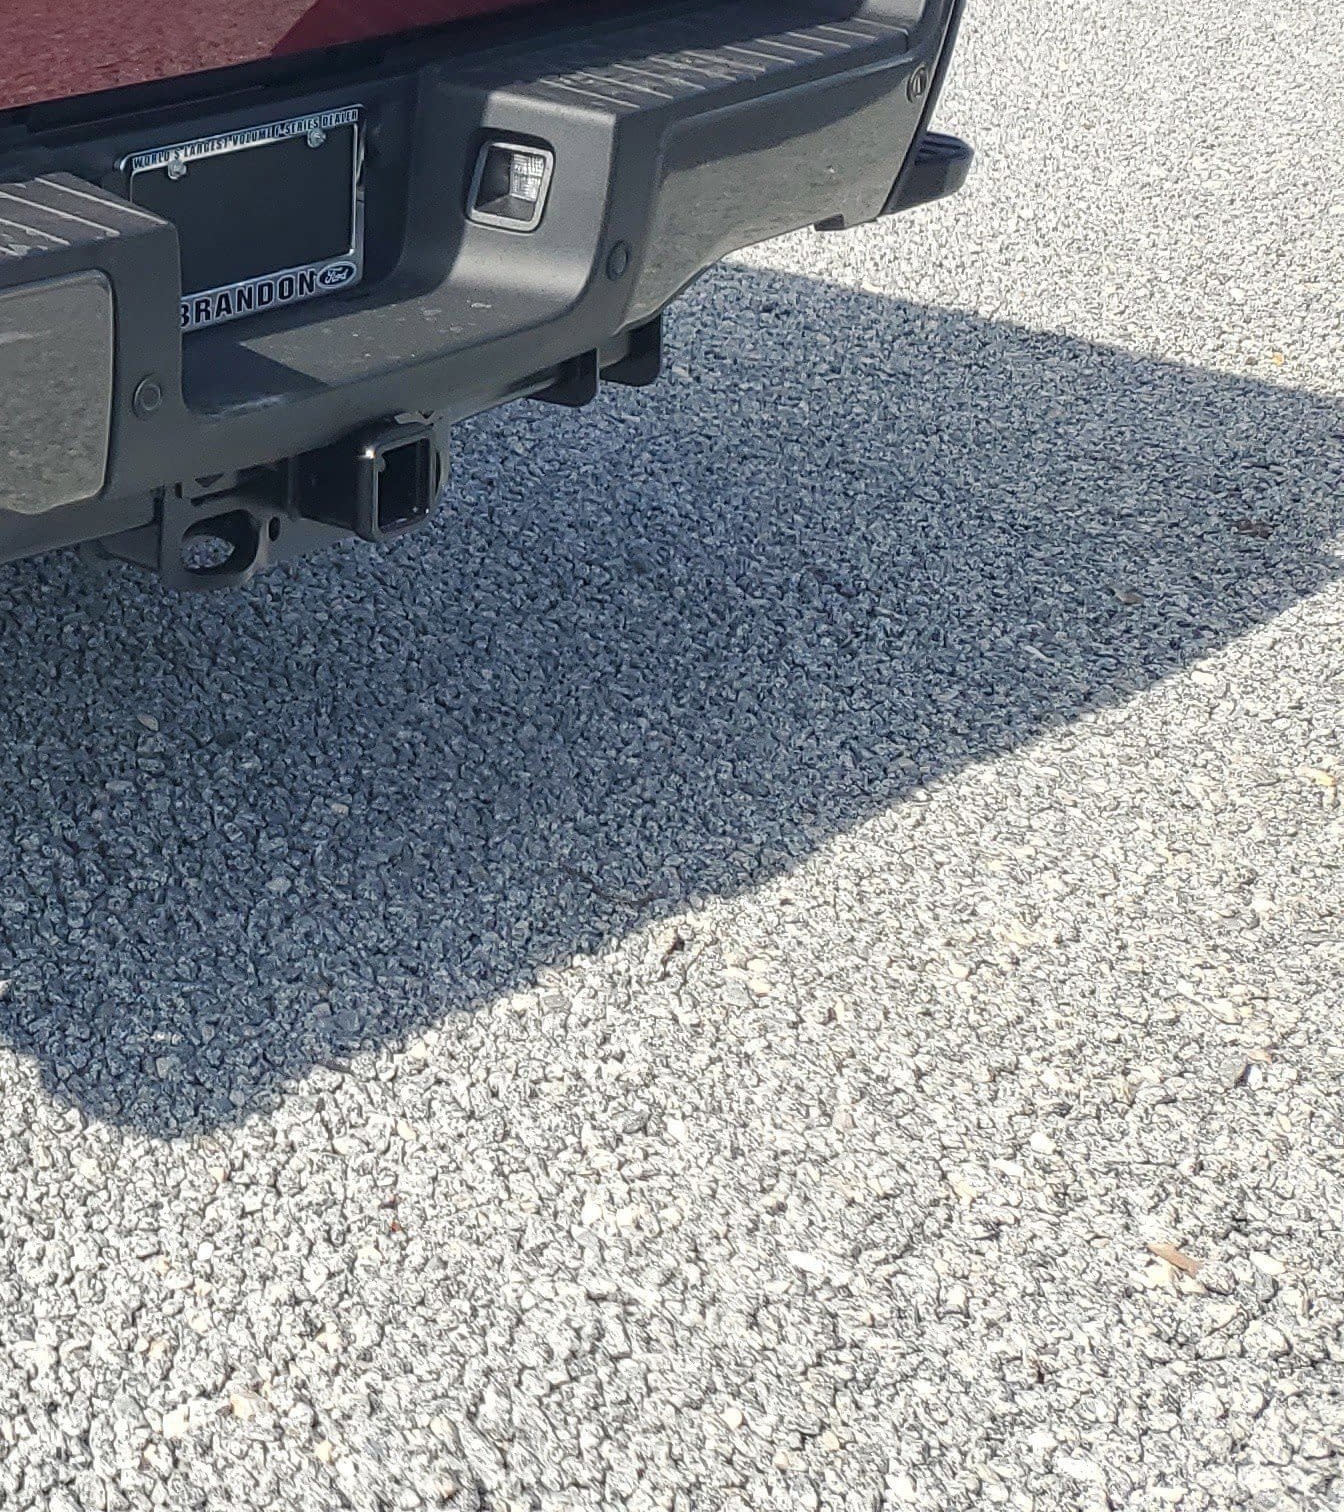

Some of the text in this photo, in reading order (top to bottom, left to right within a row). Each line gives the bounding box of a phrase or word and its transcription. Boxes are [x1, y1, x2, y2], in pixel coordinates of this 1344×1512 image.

[132, 148, 181, 169] WORLDS
[184, 136, 230, 158] LARGEST
[231, 127, 273, 147] VOLUME
[321, 109, 358, 129] DEALER
